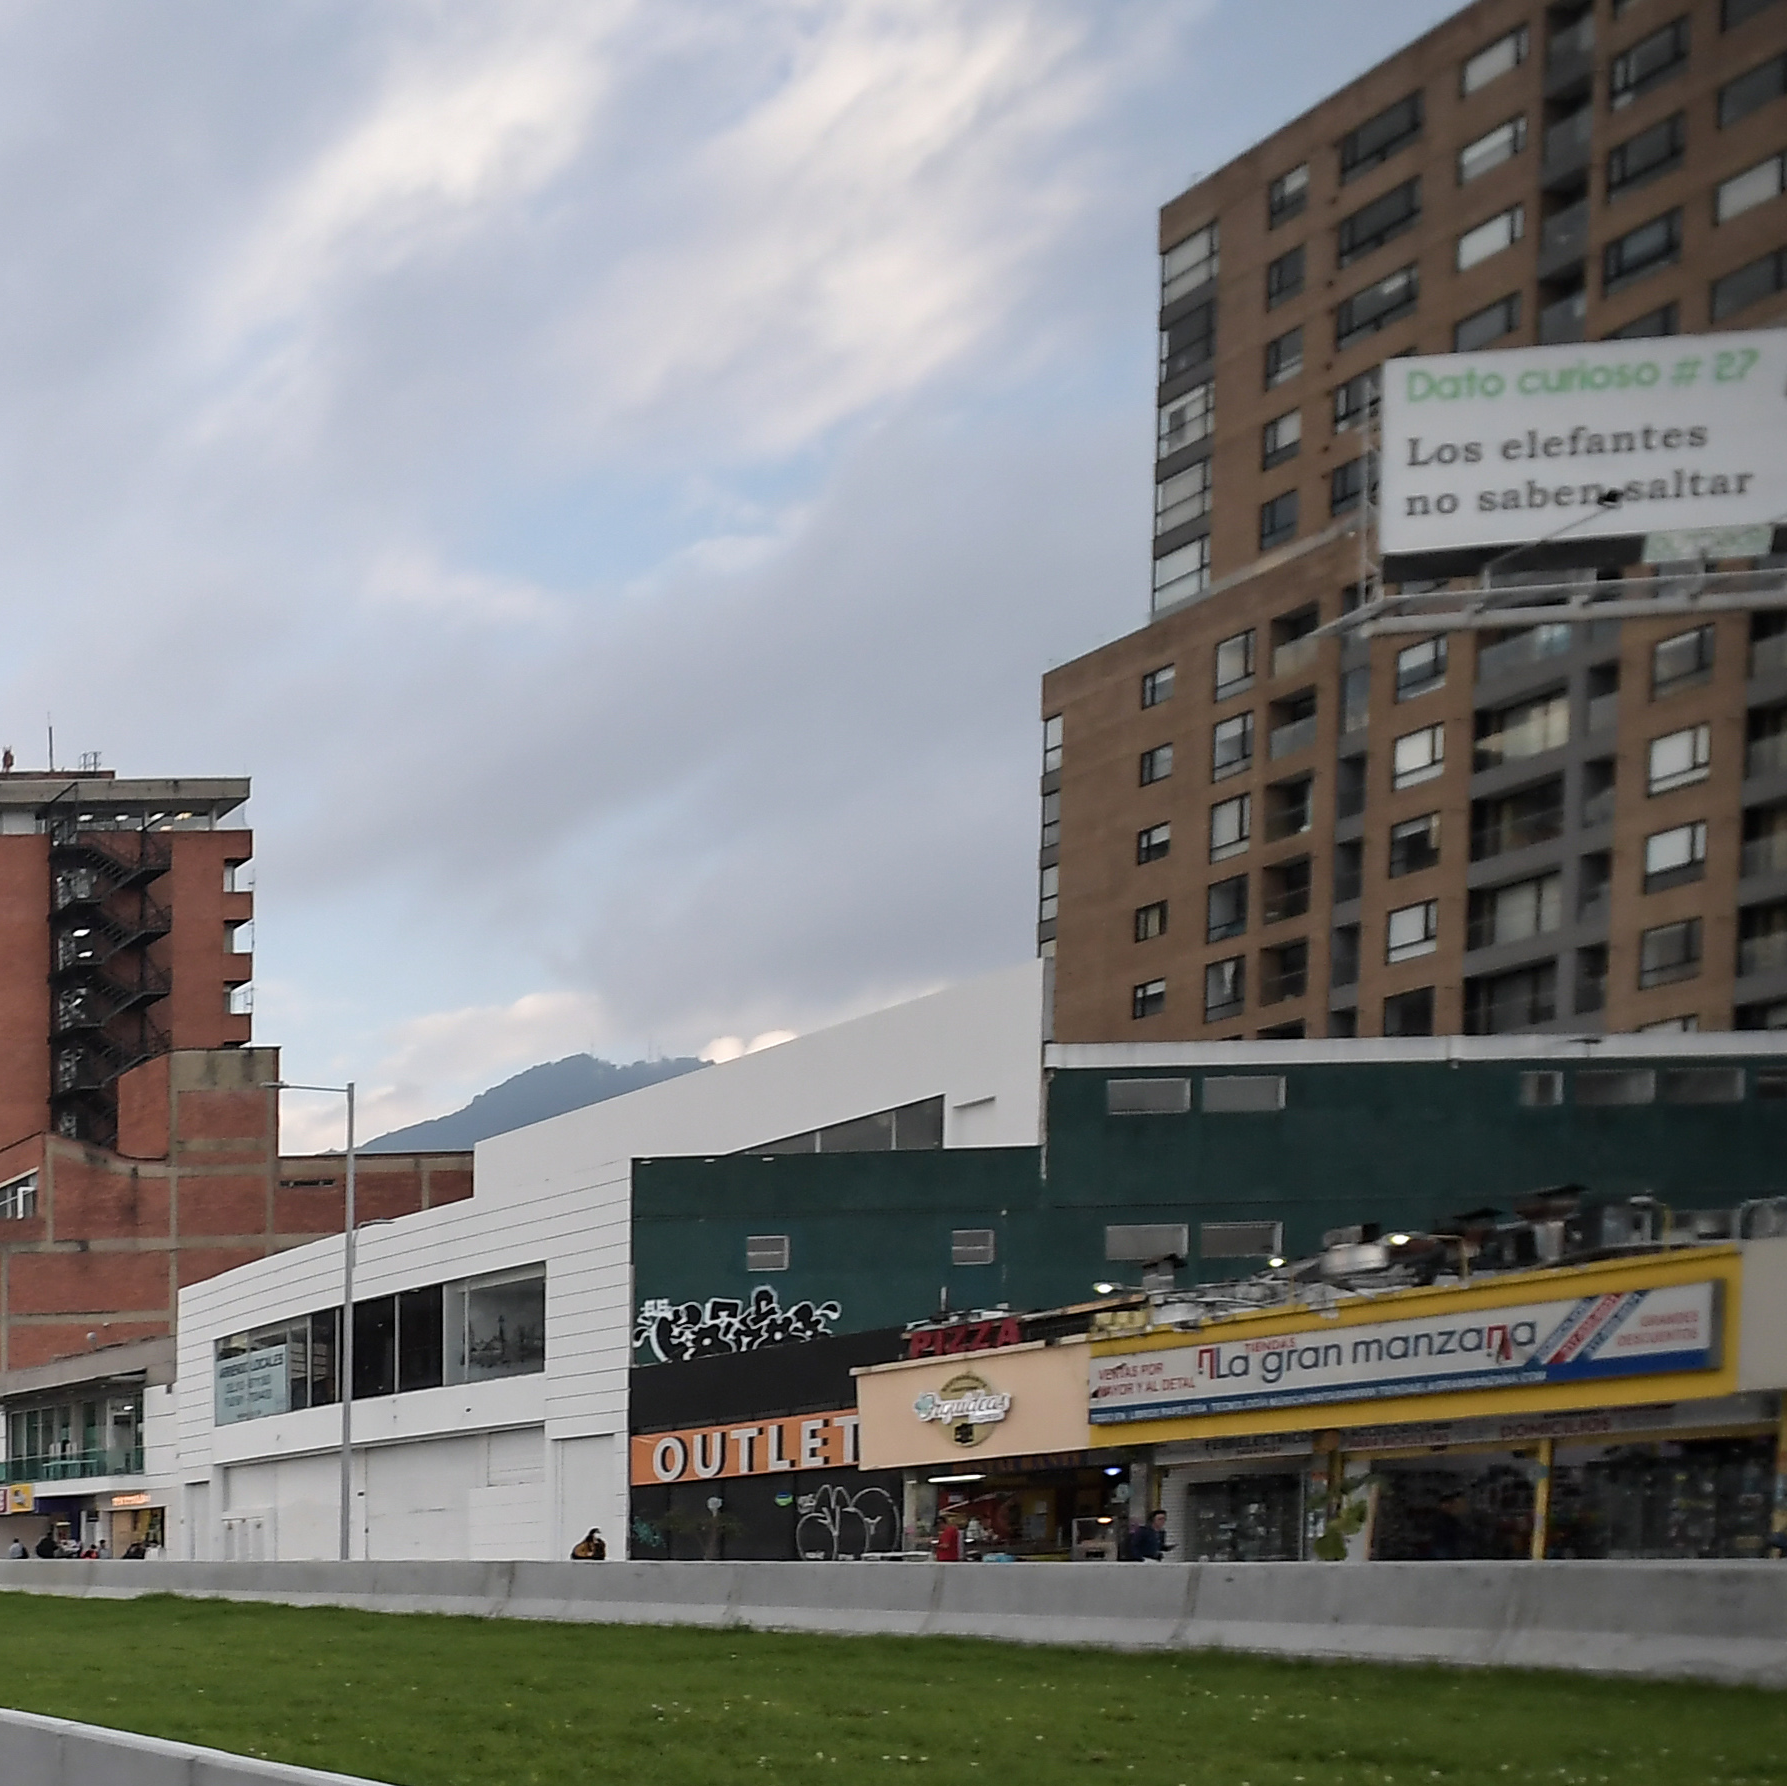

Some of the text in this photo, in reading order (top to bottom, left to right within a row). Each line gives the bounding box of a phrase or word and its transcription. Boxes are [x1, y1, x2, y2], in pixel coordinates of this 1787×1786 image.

[1406, 348, 1760, 402] Dato curioso # 27
[1406, 424, 1709, 467] Los elefantes
[1406, 469, 1754, 517] no saben saltar
[909, 1317, 1022, 1359] PIZZA
[1215, 1346, 1250, 1380] La
[1261, 1342, 1342, 1384] gran
[1352, 1320, 1537, 1363] manzana
[1141, 1362, 1164, 1377] POR
[652, 1414, 859, 1482] OUTLET
